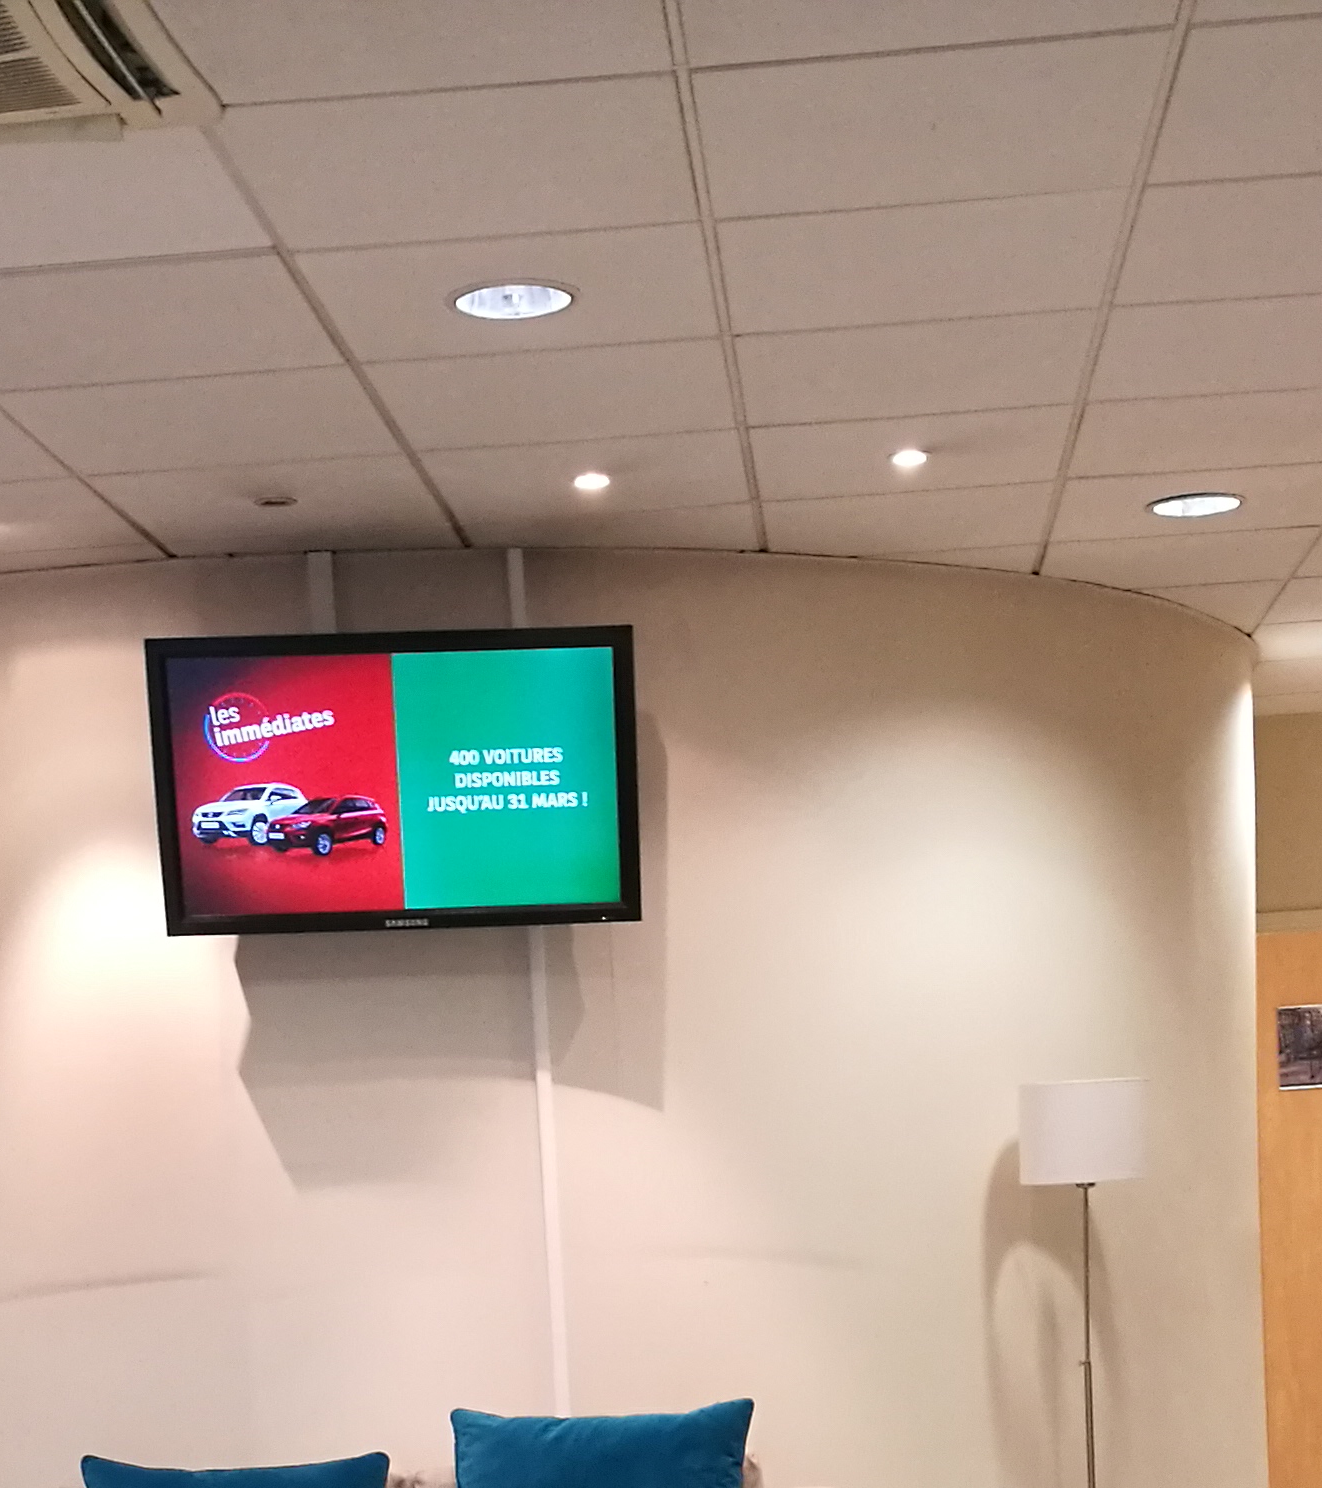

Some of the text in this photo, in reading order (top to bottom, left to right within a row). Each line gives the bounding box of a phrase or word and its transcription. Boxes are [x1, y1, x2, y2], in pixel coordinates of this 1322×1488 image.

[209, 706, 241, 726] les
[214, 710, 335, 747] immédiates
[449, 747, 564, 766] 400 VOITURES
[454, 770, 561, 789] DISPONIBLES
[427, 791, 588, 814] JUSQU'AU 31 MARS !
[385, 918, 429, 928] SAMSUNG
